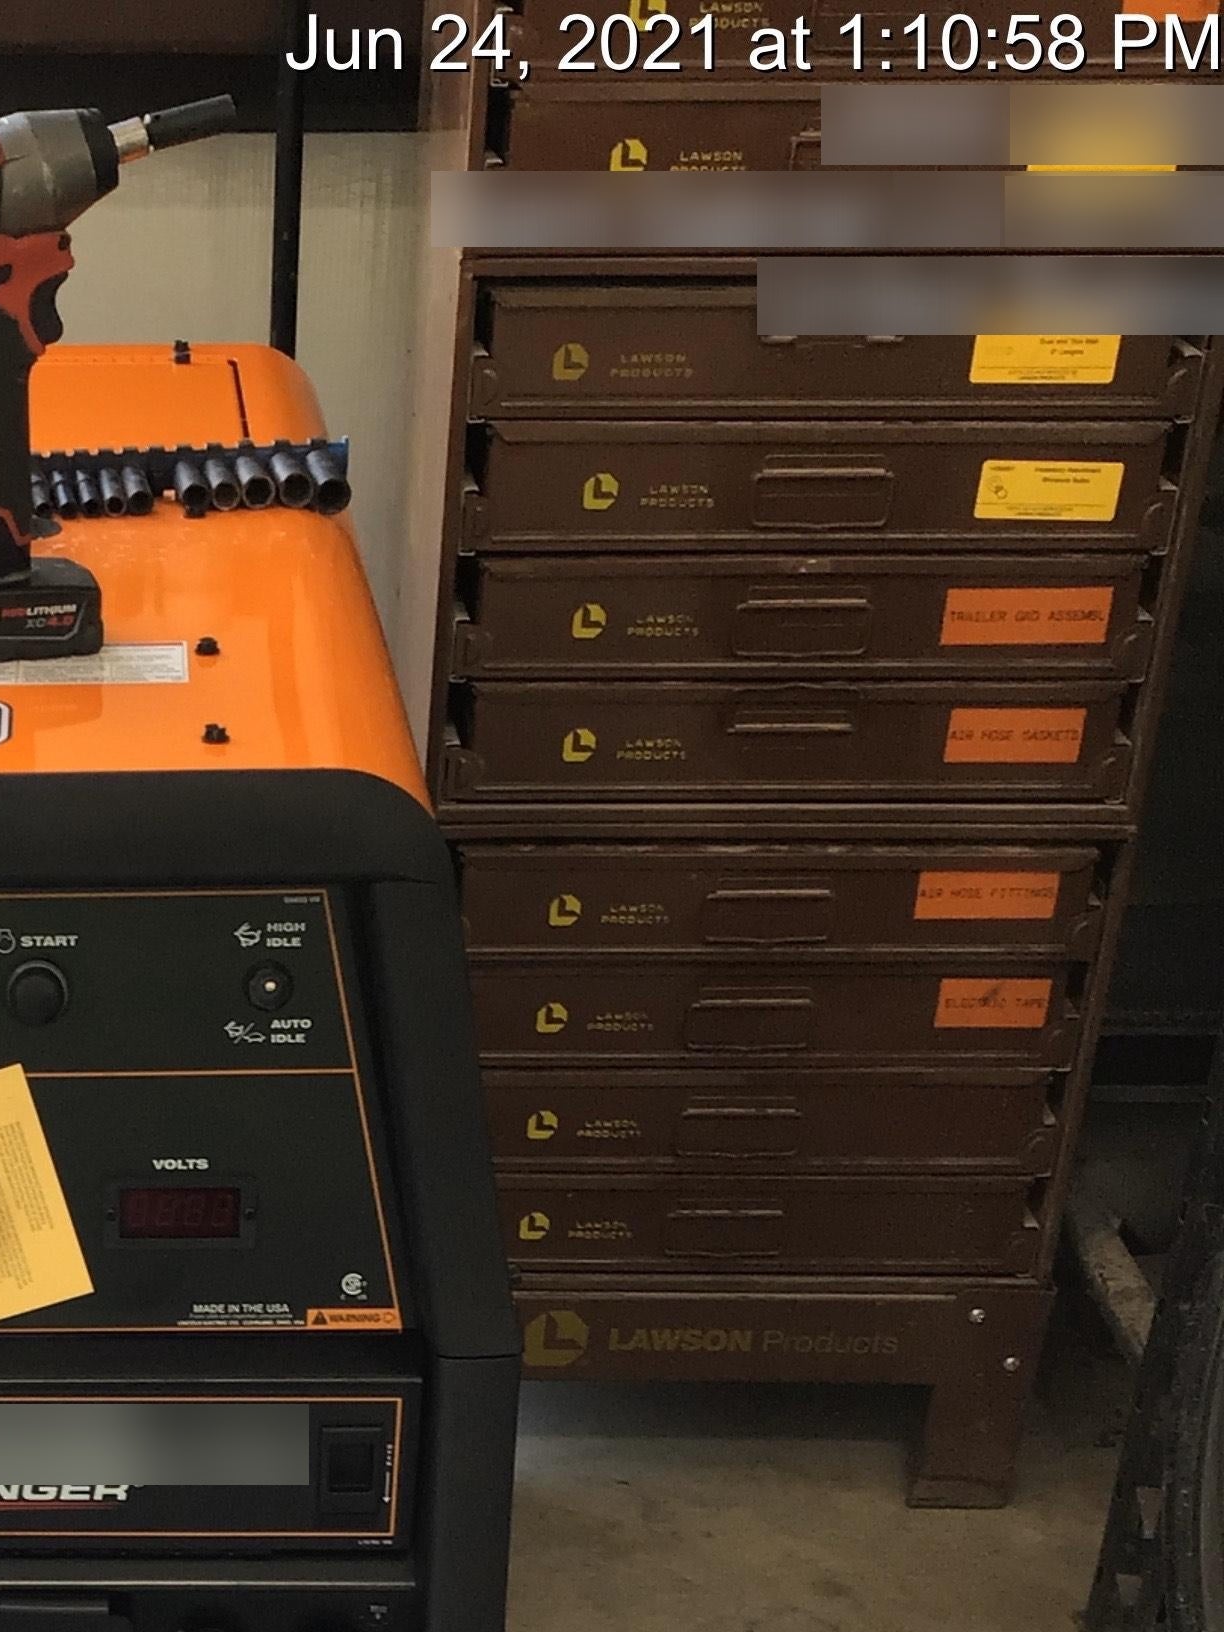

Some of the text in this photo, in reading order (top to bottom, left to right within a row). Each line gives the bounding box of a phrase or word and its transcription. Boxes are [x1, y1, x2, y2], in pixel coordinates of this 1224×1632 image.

[699, 1, 764, 13] LAWSON
[679, 151, 743, 162] LAWSON
[266, 922, 306, 933] HIGH
[20, 935, 78, 948] START
[266, 937, 302, 948] IDLE
[270, 1018, 312, 1030] AUTO
[270, 1033, 306, 1045] IDLE
[152, 1158, 209, 1171] VOLTS
[192, 1303, 290, 1314] MADE IN THE USA
[328, 1314, 381, 1323] WARNING
[609, 1327, 899, 1354] LAWSON Products
